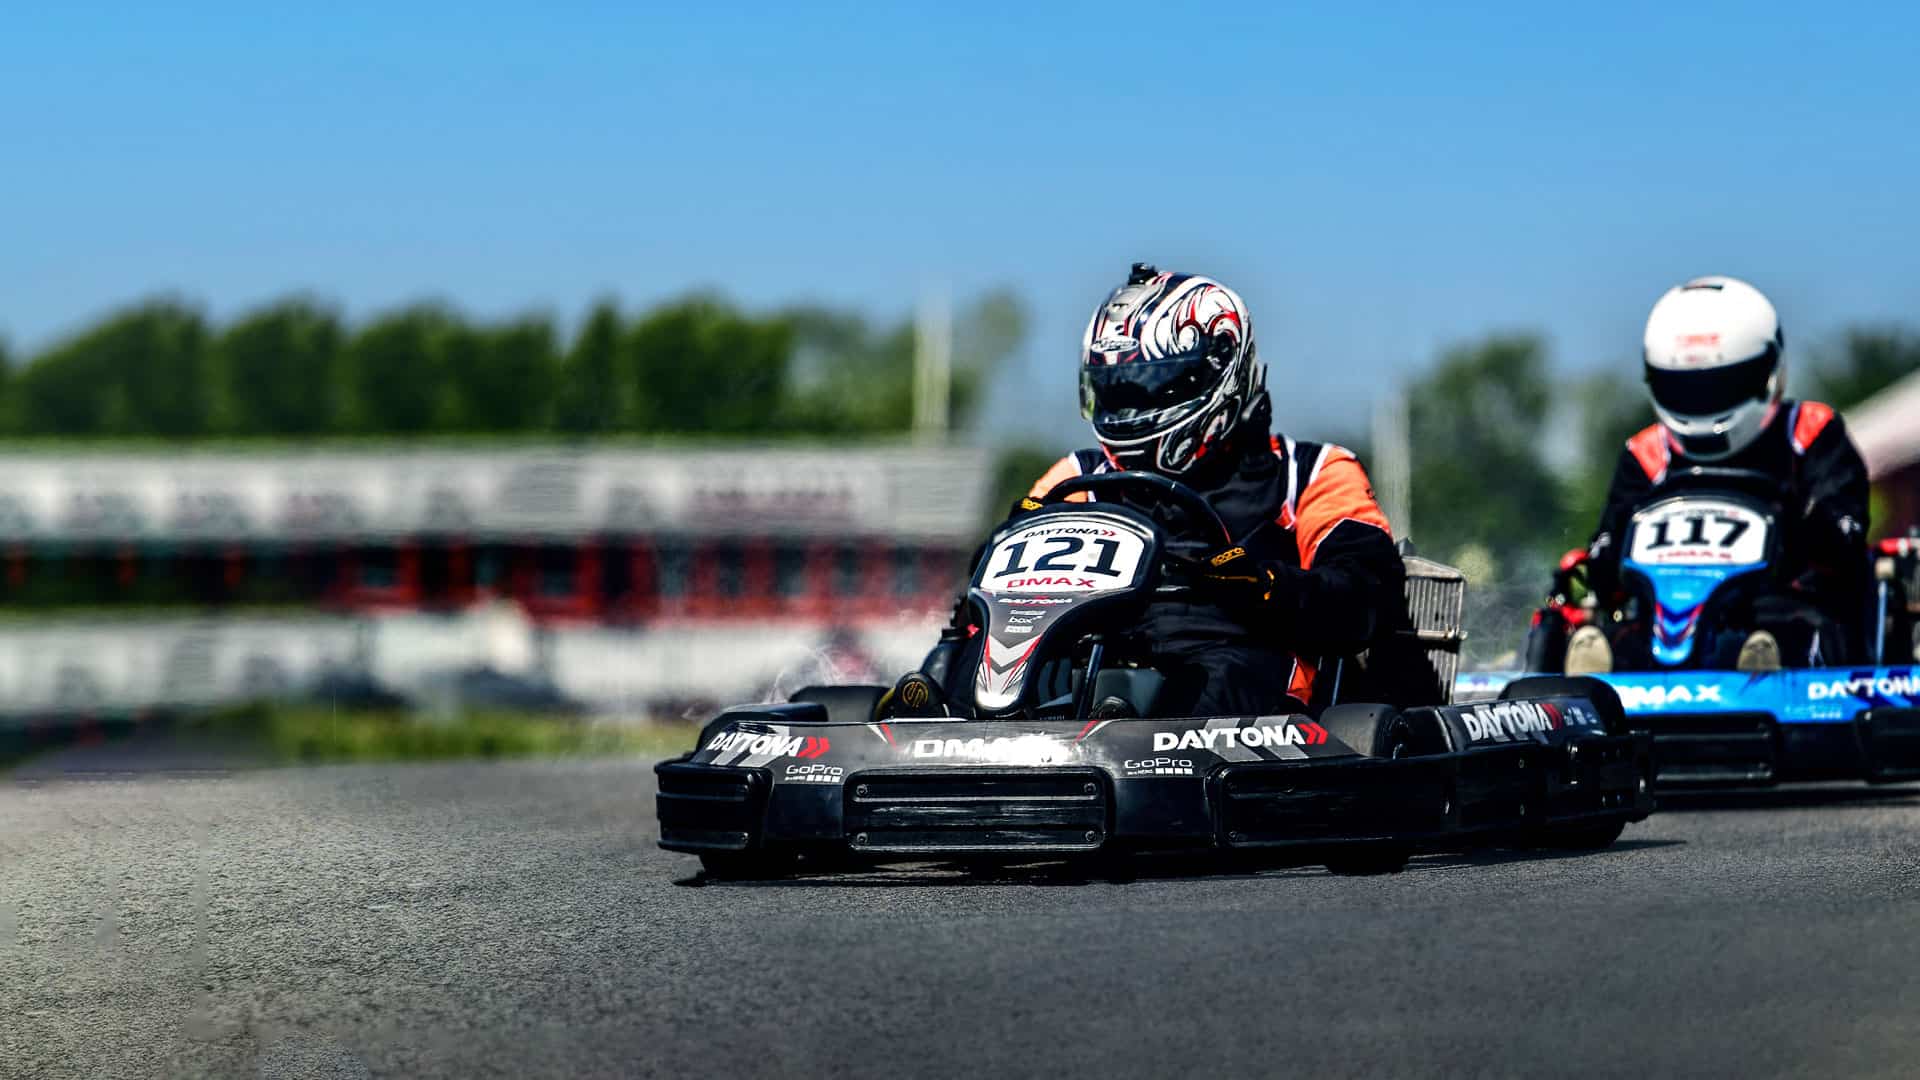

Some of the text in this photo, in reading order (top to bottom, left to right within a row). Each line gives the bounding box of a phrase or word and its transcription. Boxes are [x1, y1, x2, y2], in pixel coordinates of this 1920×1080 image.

[1024, 527, 1099, 538] DAYTONA
[1646, 515, 1750, 549] 117
[993, 536, 1121, 578] 121
[1007, 576, 1096, 588] DMAX
[1461, 703, 1553, 741] DAYTONA
[705, 732, 804, 757] DAYTONA
[914, 737, 1068, 762] DM
[1153, 723, 1306, 751] DAYTONA
[786, 764, 843, 776] GoPro
[1124, 757, 1193, 769] GoPro
